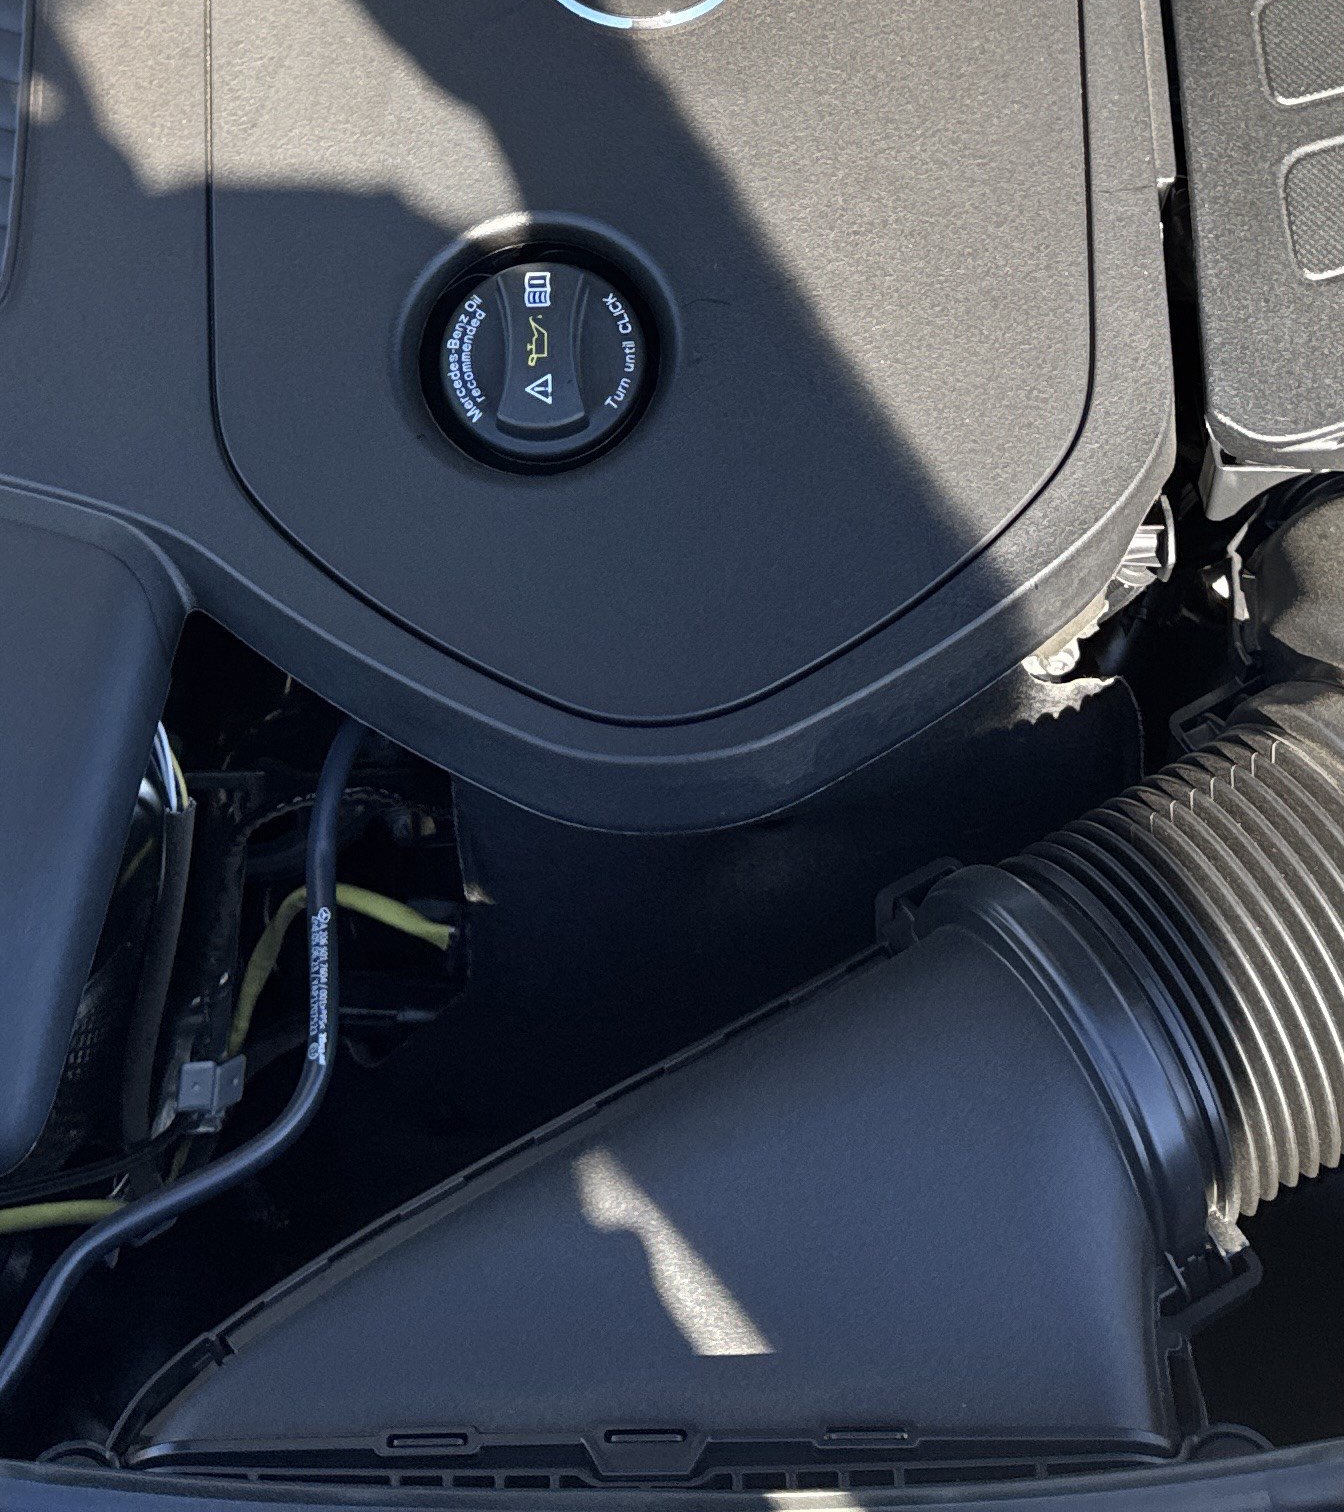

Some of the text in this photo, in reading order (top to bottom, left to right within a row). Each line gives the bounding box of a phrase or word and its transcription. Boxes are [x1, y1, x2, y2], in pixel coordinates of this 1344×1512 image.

[447, 294, 484, 423] Mercedes-Benz Oil
[462, 310, 485, 403] recommended
[601, 292, 636, 410] Turn until CLICK
